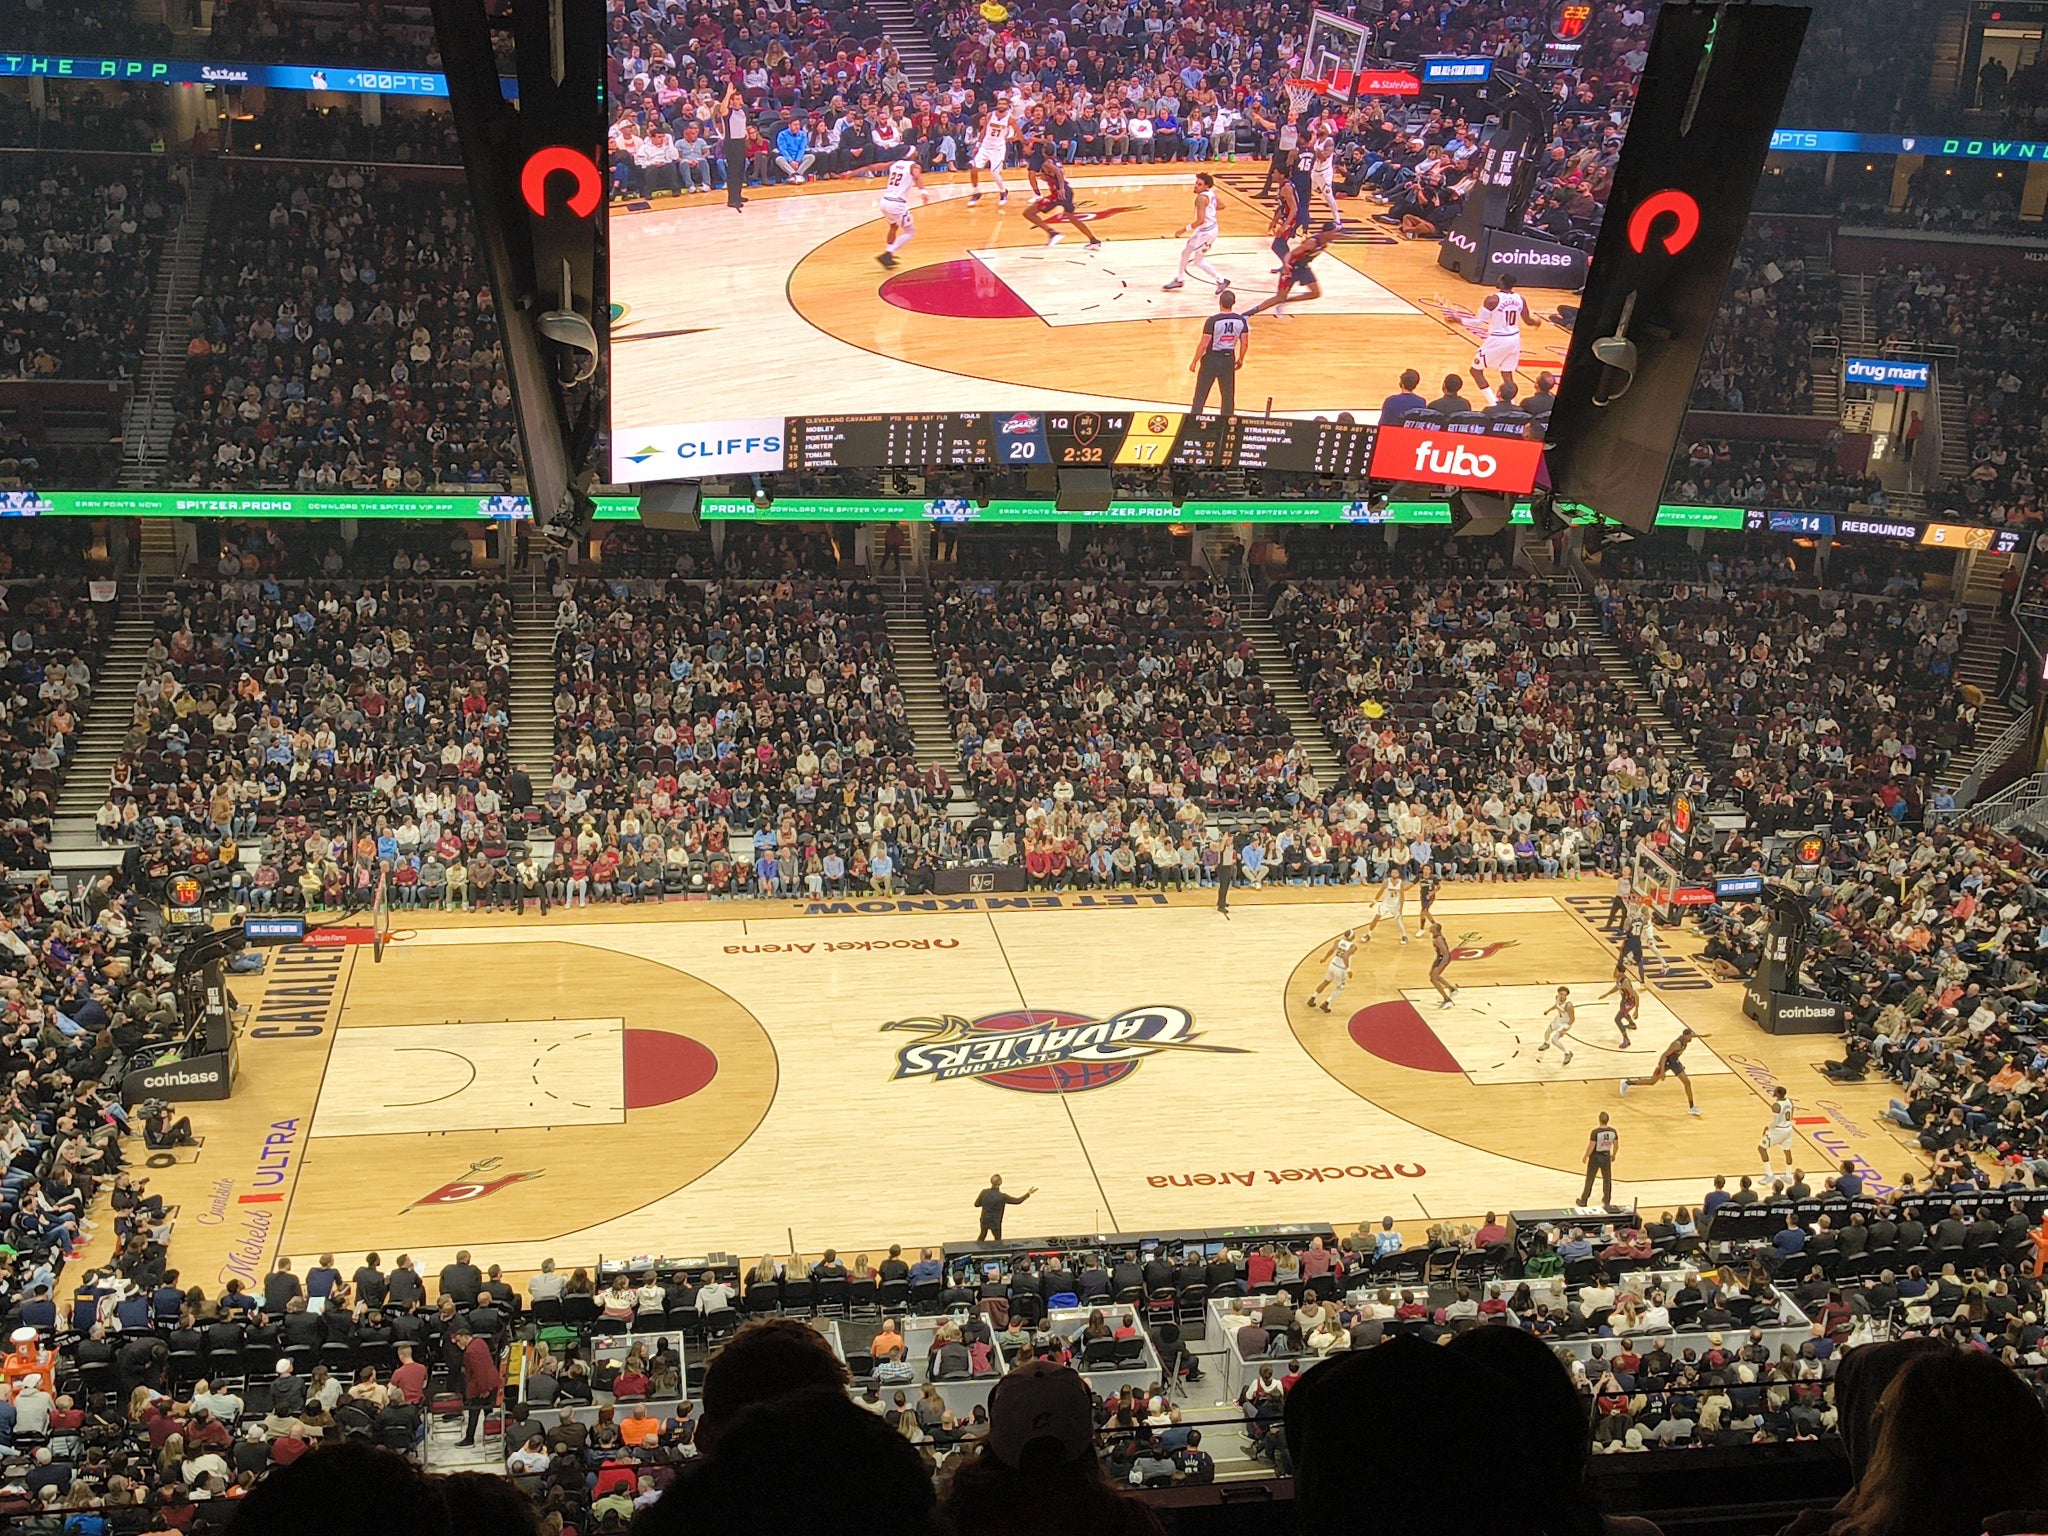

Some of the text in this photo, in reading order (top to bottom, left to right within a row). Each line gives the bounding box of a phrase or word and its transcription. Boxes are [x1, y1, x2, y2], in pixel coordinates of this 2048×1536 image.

[1564, 6, 1590, 20] 2:32
[1562, 19, 1582, 35] 14
[6, 57, 168, 78] THE APP
[347, 73, 436, 92] +100PTS
[1298, 158, 1312, 171] 45
[1492, 249, 1572, 267] coinbase
[1505, 310, 1517, 326] 10
[1848, 361, 1928, 381] drug mart
[1051, 418, 1068, 429] 1Q
[1107, 418, 1122, 428] 14
[677, 436, 780, 458] CLIFFS
[1010, 442, 1036, 459] 20
[1064, 448, 1102, 462] 2:32
[1134, 444, 1158, 460] 17
[1415, 441, 1497, 478] fubo
[176, 500, 292, 511] SPITZER.PROMO
[701, 504, 755, 514] R.PROMO
[1748, 520, 1762, 529] 47
[1800, 517, 1820, 531] 14
[1841, 520, 1916, 538] REBOUNDS
[1934, 528, 1946, 543] 5
[1997, 541, 2015, 552] 37
[176, 880, 197, 891] 2:32
[180, 890, 194, 902] 14
[1072, 893, 1169, 907] LET
[723, 938, 930, 955] Rocket Arena
[1779, 1006, 1836, 1018] coinbase
[905, 1005, 1191, 1076] CAVALIERS
[943, 1050, 1061, 1079] CLEVELAND
[144, 1071, 219, 1088] coinbase
[252, 1117, 300, 1187] ULTRA
[1147, 1163, 1394, 1188] Rocket Arena
[198, 1177, 235, 1226] Courtside
[1381, 1239, 1400, 1252] 45
